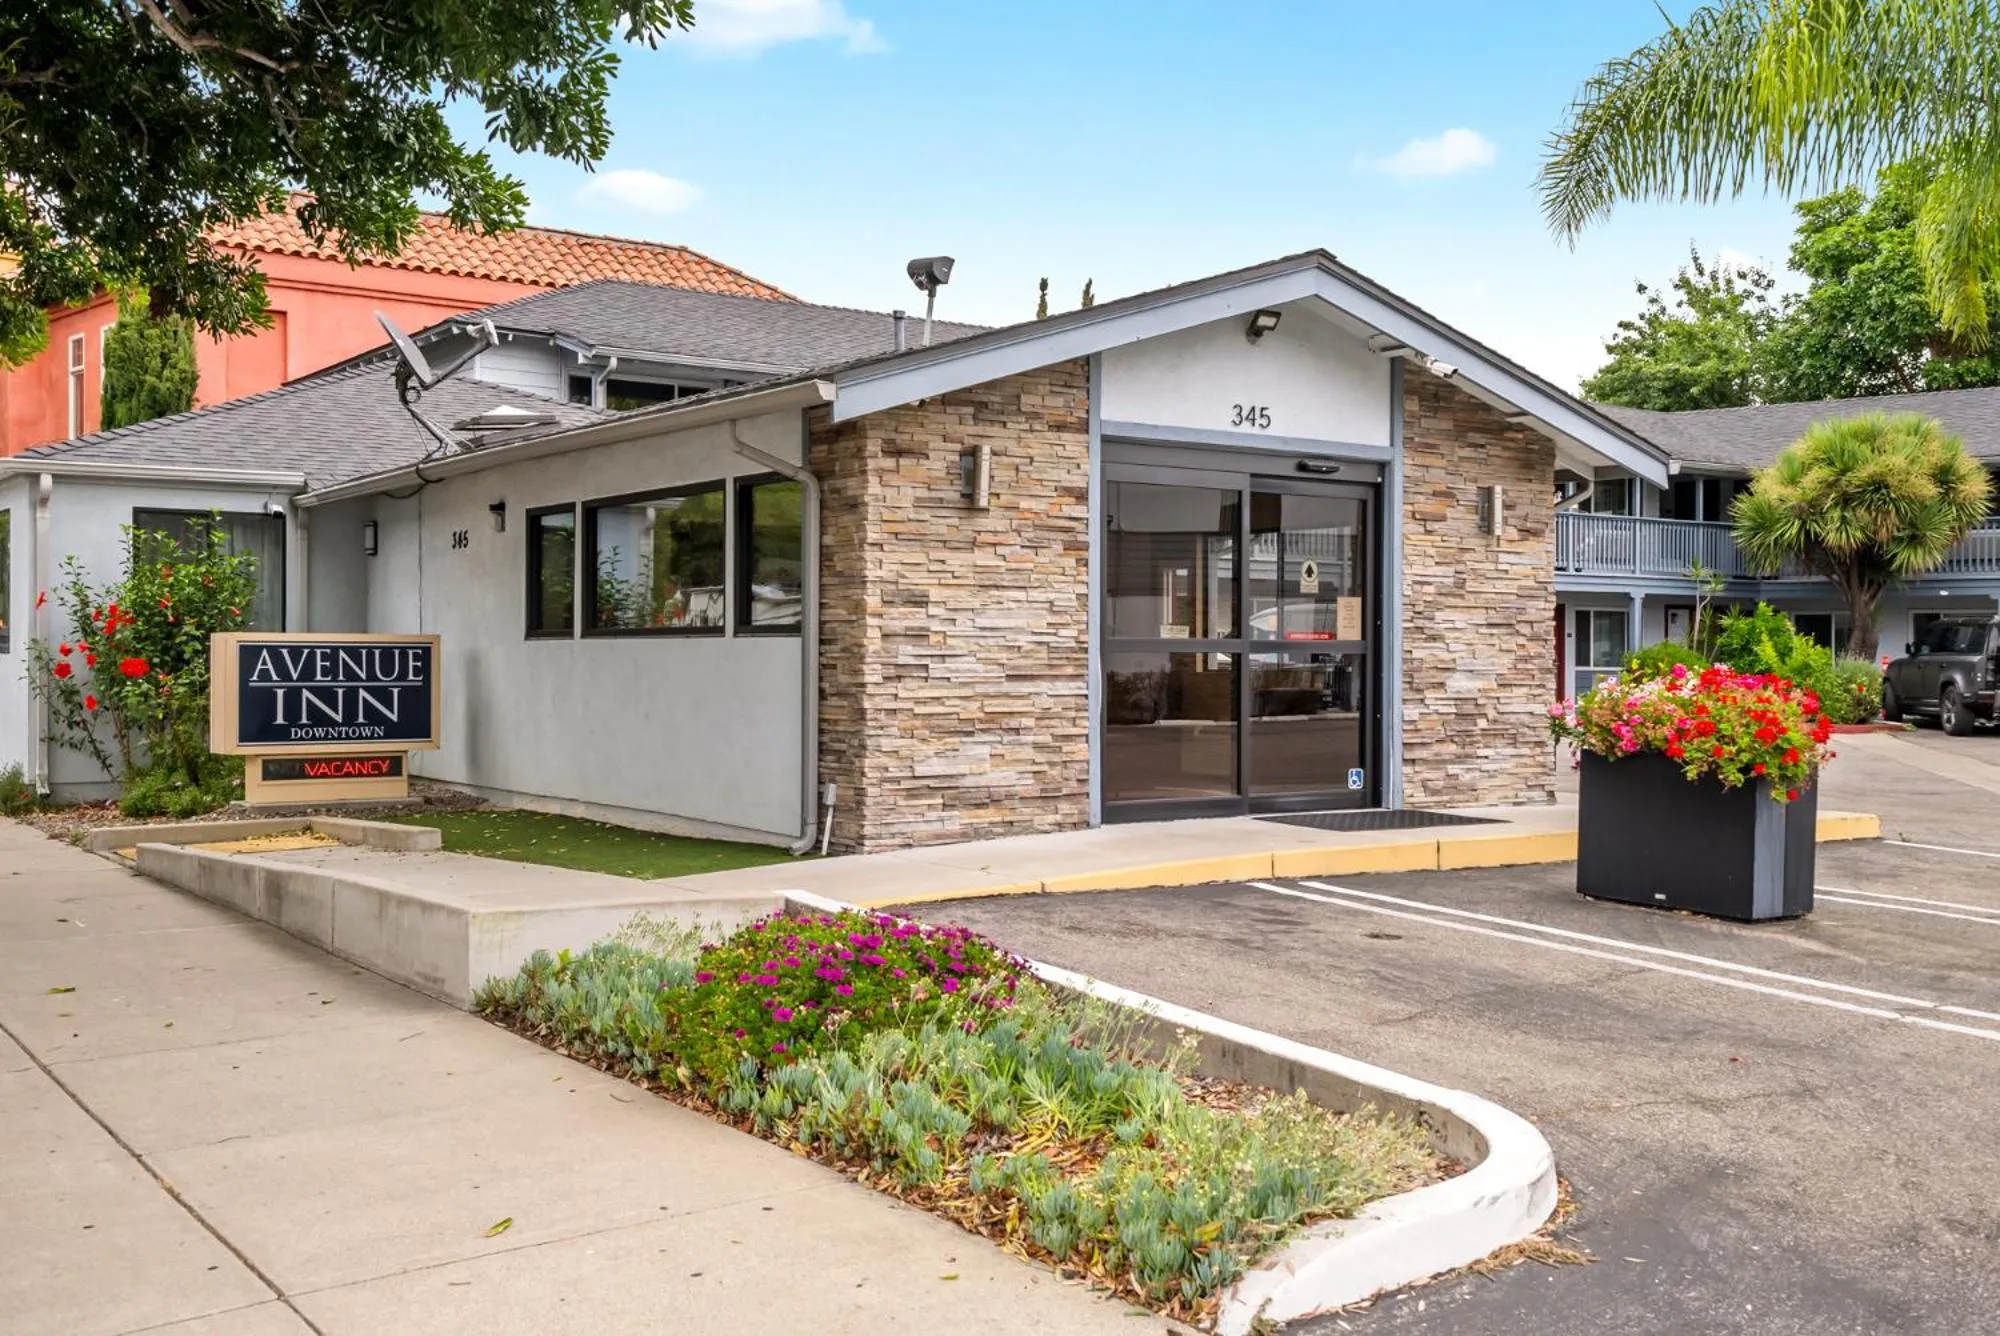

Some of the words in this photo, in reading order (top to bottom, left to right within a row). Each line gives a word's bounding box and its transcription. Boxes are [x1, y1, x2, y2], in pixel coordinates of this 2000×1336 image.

[1231, 403, 1272, 429] 345
[452, 529, 469, 549] 345
[249, 647, 424, 682] AVENUE
[271, 687, 402, 724] INN
[290, 726, 386, 740] DOWNTOWN
[304, 759, 391, 777] VACANCY
